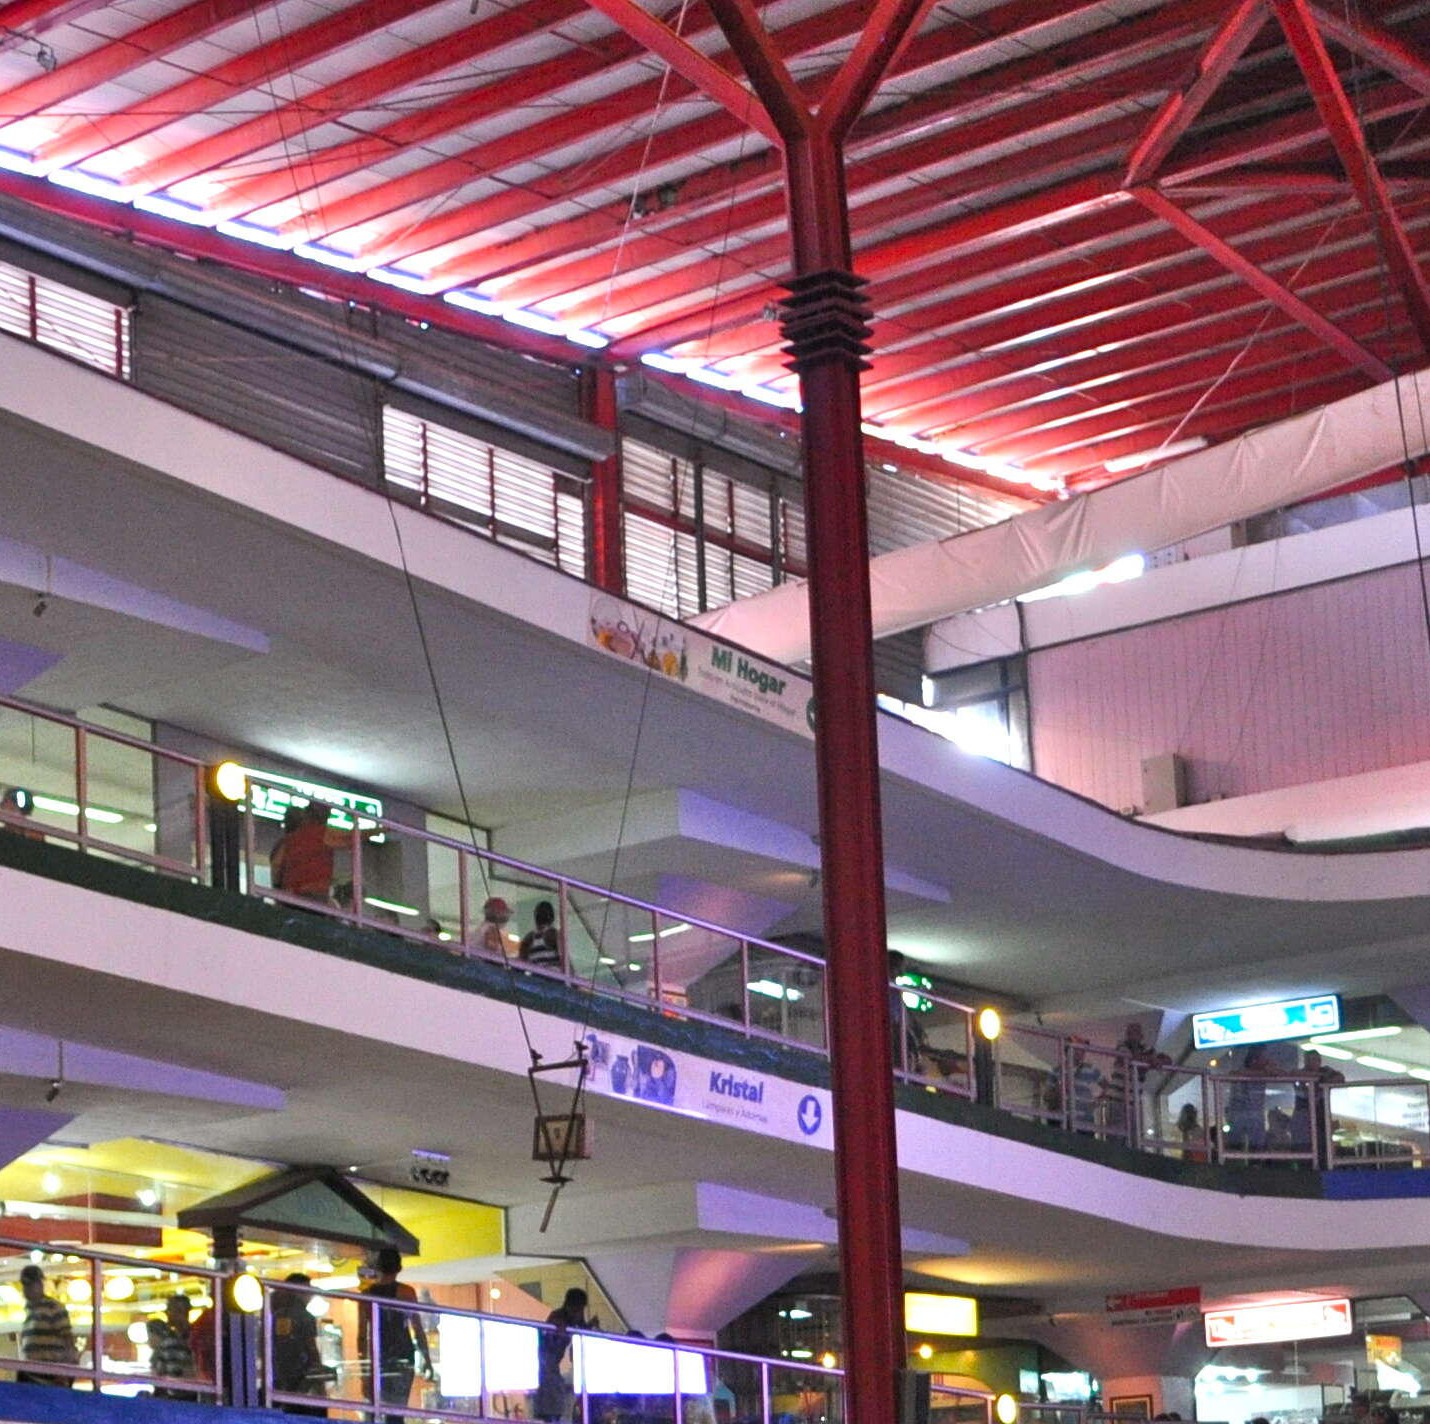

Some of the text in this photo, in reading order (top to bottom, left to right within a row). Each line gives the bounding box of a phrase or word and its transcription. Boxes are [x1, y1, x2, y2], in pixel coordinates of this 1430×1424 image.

[711, 645, 786, 696] Mi Hogar
[709, 1071, 764, 1104] Kristal
